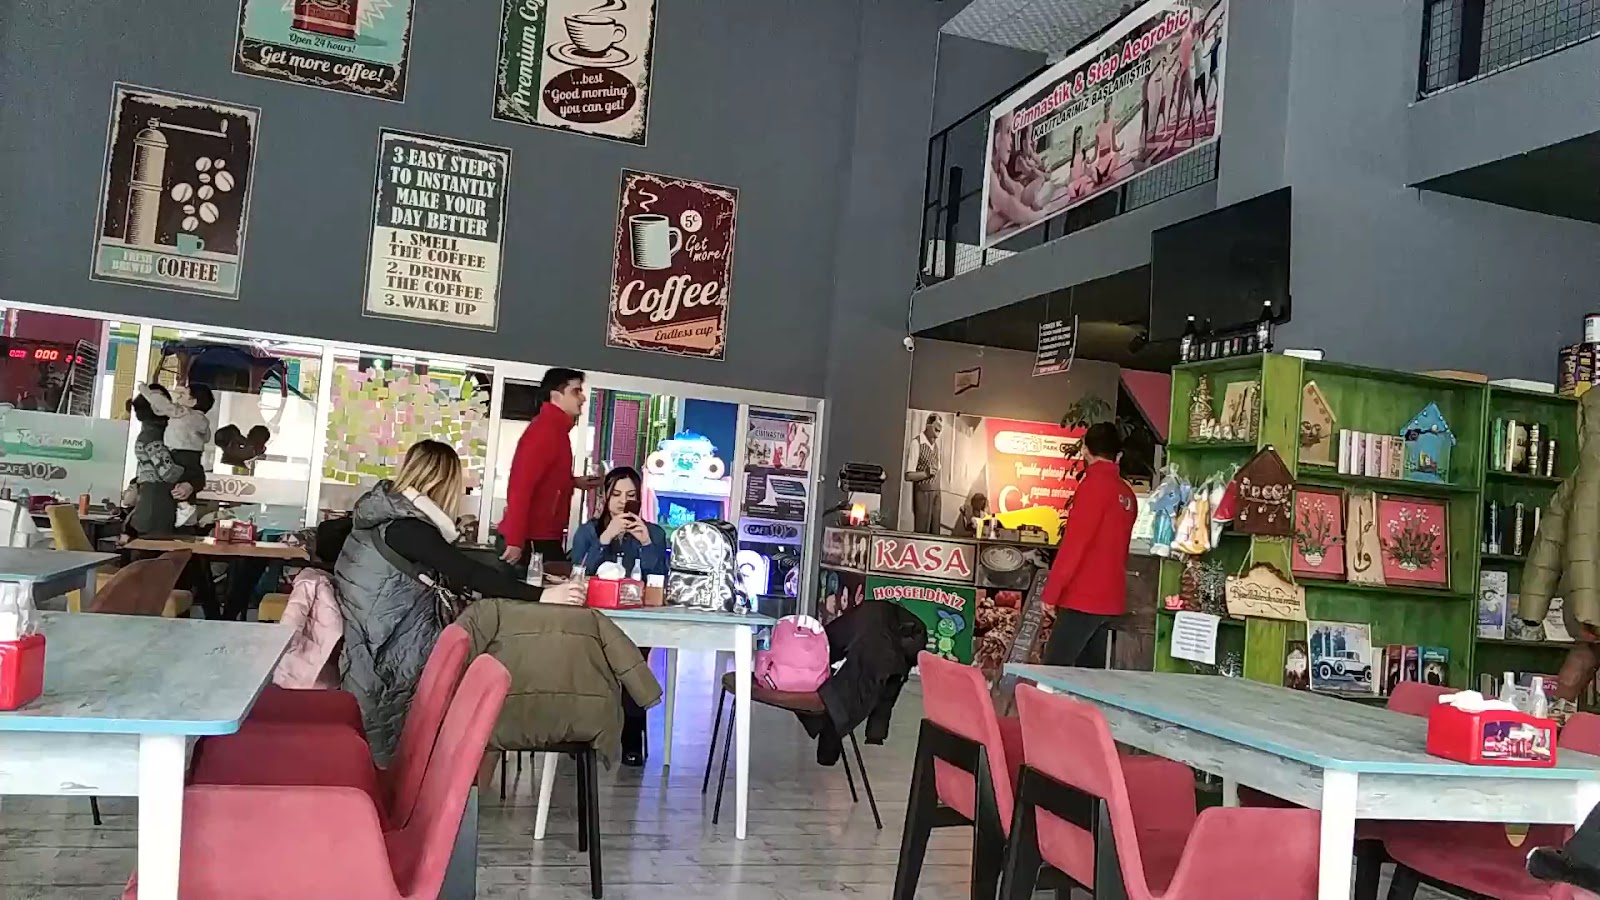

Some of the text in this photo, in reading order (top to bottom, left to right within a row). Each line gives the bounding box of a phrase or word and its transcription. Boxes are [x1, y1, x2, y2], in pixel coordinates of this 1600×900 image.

[289, 33, 356, 53] Open 24 hours!
[1074, 72, 1084, 95] &
[1087, 54, 1119, 87] Step
[1121, 7, 1190, 67] Aeorobic
[260, 46, 384, 82] Get more coffee!
[512, 24, 536, 106] Premium
[560, 100, 624, 118] you can get!
[1033, 98, 1089, 140] KAYITLARIMIZ
[392, 146, 496, 179] 3 EASY STEPS
[390, 167, 496, 198] TO INSTANTLY
[396, 187, 487, 216] MAKE YOUR
[391, 206, 488, 237] DAY BETTER
[389, 231, 459, 252] 1. SMELL
[685, 235, 708, 258] Get
[693, 242, 729, 263] more!
[389, 243, 486, 269] THE COFFEE
[156, 257, 218, 282] COFFEE
[387, 262, 463, 283] 2. DRINK
[386, 275, 483, 300] THE COFFEE
[619, 274, 720, 323] Coffee
[384, 293, 476, 316] 3. WAKE UP
[654, 326, 714, 341] Endless cup
[62, 439, 83, 447] PARK
[22, 462, 59, 481] JOY
[216, 479, 248, 496] JOY
[874, 538, 971, 577] KASA
